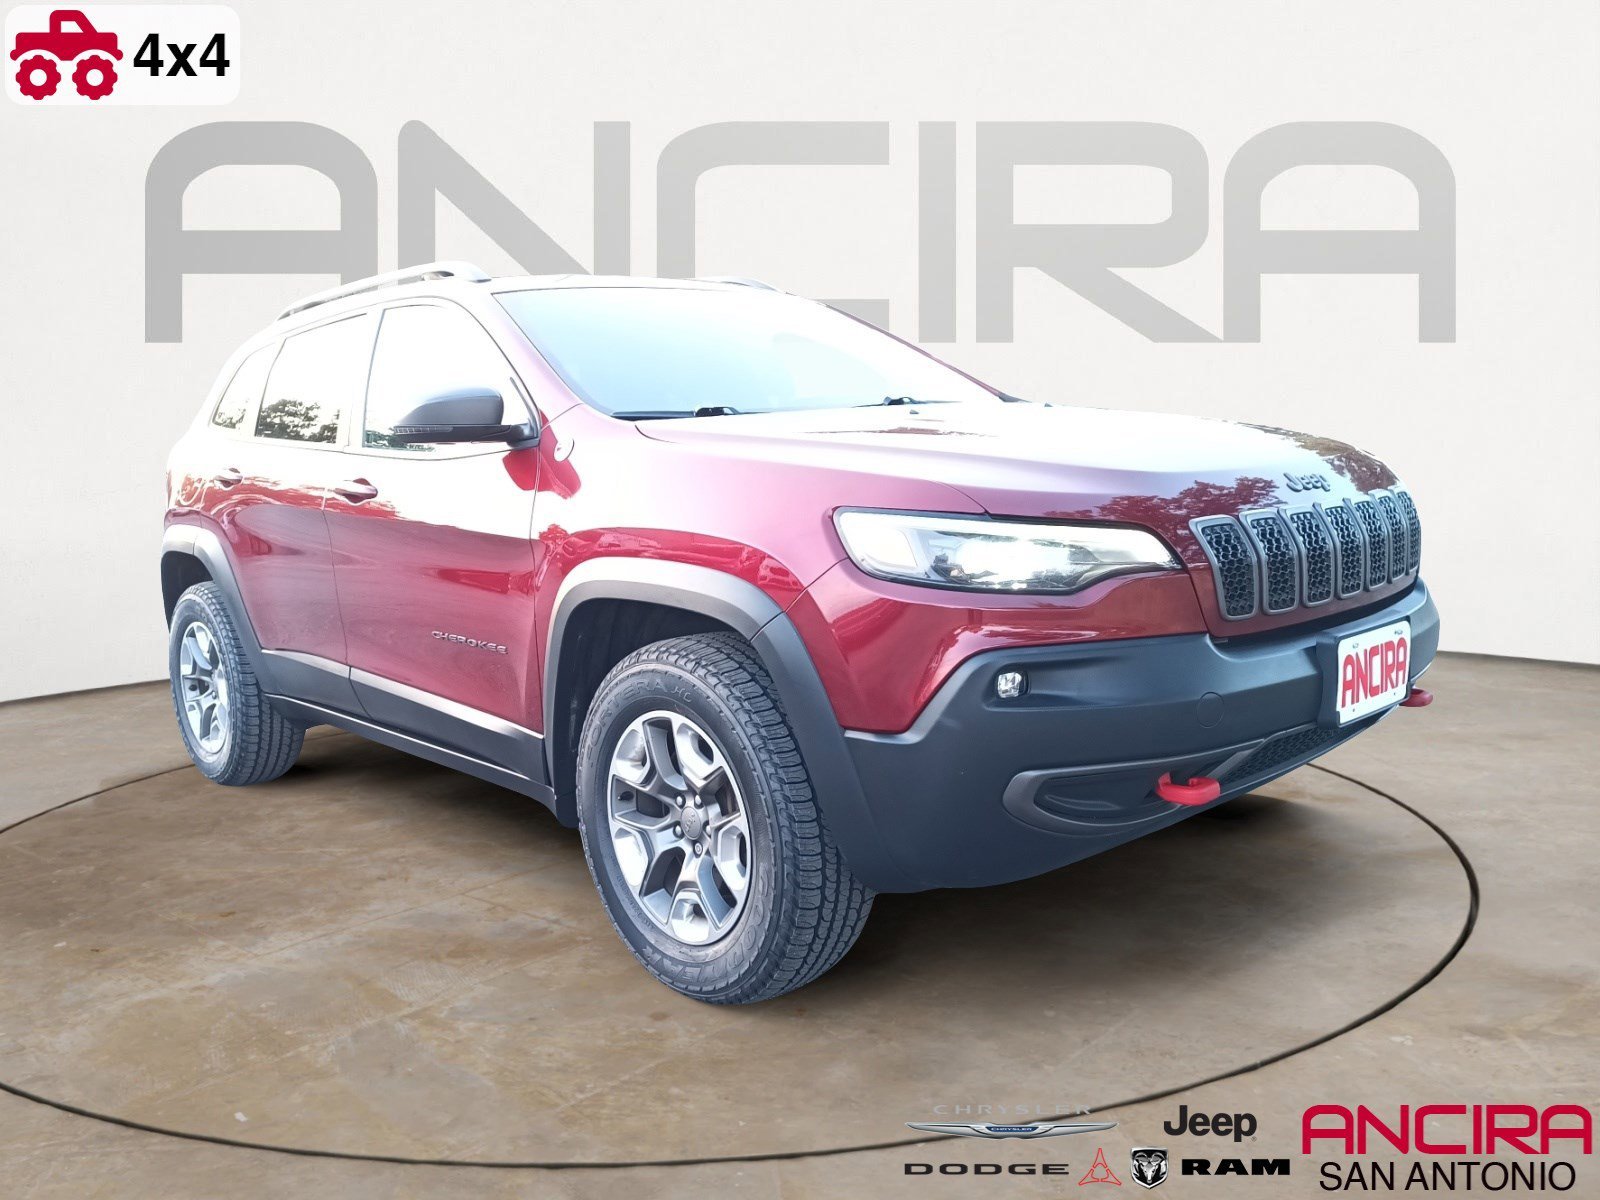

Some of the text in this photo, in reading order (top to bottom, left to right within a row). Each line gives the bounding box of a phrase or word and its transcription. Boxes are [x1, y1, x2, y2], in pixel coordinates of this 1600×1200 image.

[145, 119, 1457, 343] ANCIRA
[1284, 472, 1330, 492] Jeep
[431, 630, 508, 654] CHEROKEE
[1341, 636, 1408, 708] ANCIRA
